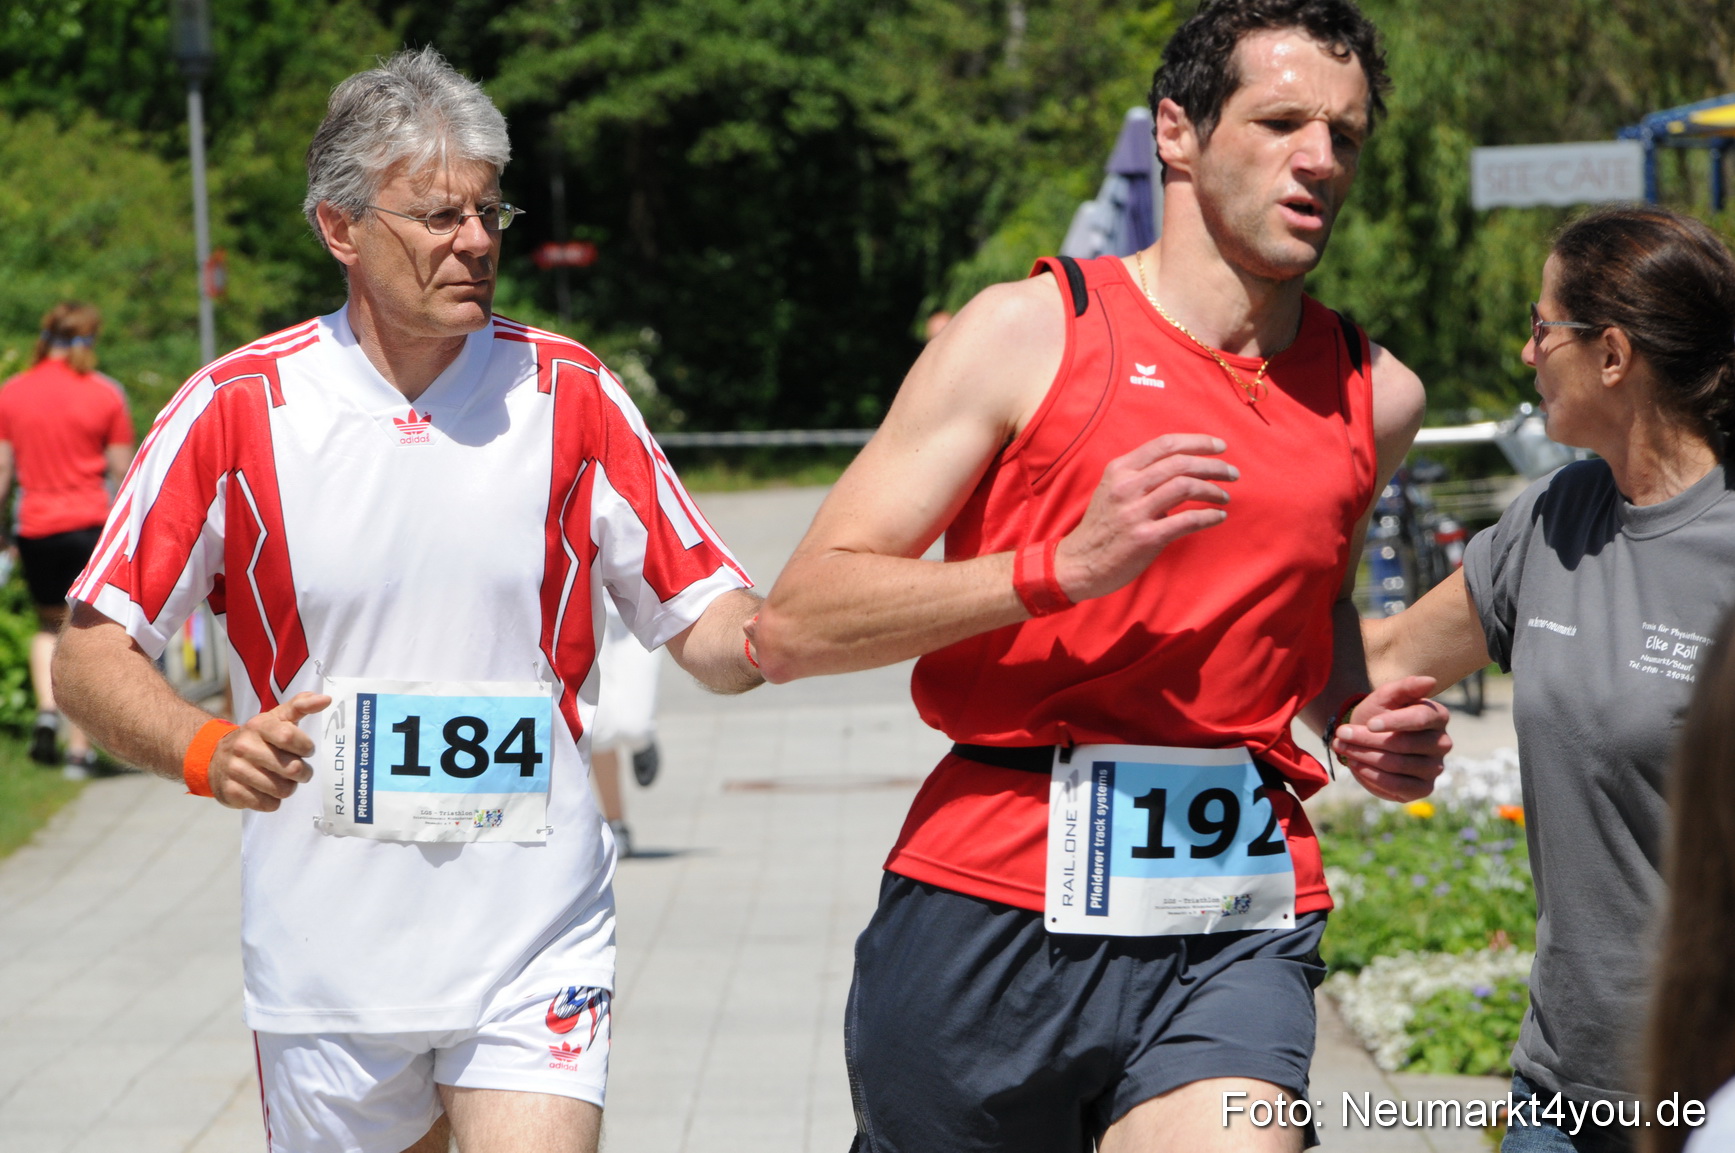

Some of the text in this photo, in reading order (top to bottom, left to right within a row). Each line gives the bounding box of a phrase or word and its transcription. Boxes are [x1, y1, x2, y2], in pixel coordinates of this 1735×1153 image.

[1129, 375, 1165, 389] erima
[399, 436, 430, 445] adidas
[1645, 635, 1698, 660] Elke Röll
[1657, 624, 1669, 633] für
[1640, 654, 1693, 672] Neumarkt/Stauf
[357, 699, 371, 818] Pfleiderer track systems
[390, 715, 543, 779] 184
[335, 734, 346, 816] RAIL.ONE
[1090, 769, 1109, 909] Pfleiderer track systems
[1131, 784, 1287, 859] 192
[1062, 809, 1078, 907] RAIL.ONE
[548, 1062, 578, 1072] adidas
